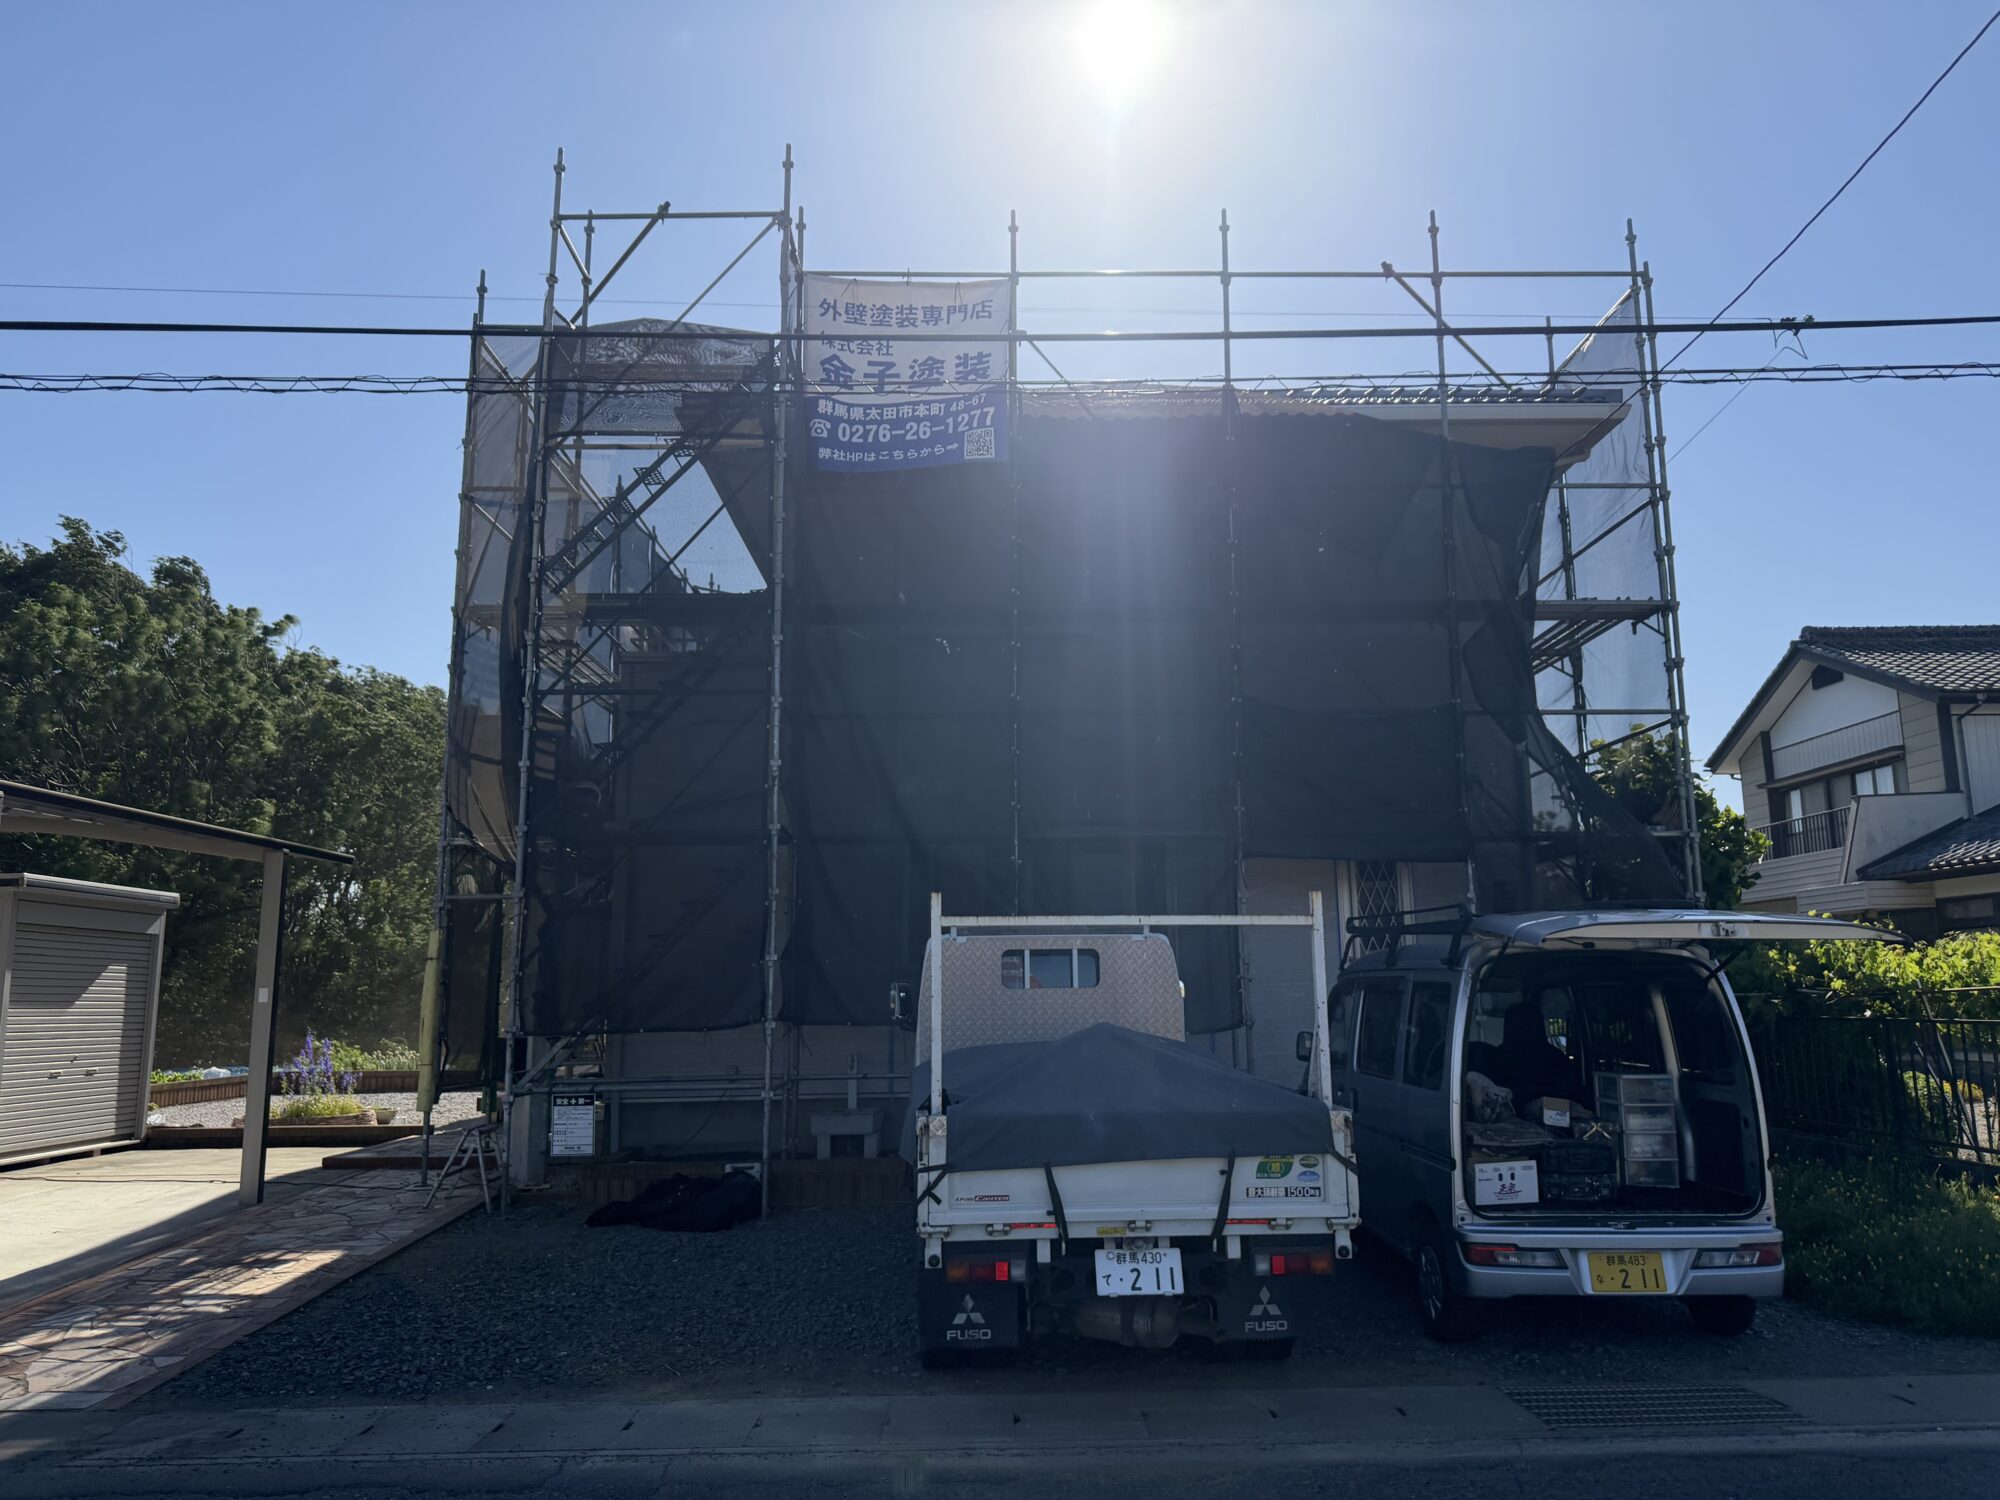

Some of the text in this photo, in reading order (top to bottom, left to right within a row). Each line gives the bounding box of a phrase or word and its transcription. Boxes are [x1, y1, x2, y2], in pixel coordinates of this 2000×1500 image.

[819, 298, 993, 328] 外壁塗装専門店
[820, 330, 894, 356] 株式会社
[819, 351, 992, 395] 金子塗装
[817, 399, 946, 421] 群馬県太田市本町
[837, 406, 995, 443] 0276-26-1277
[946, 1329, 992, 1340] FUSO
[1244, 1320, 1288, 1332] FUSO
